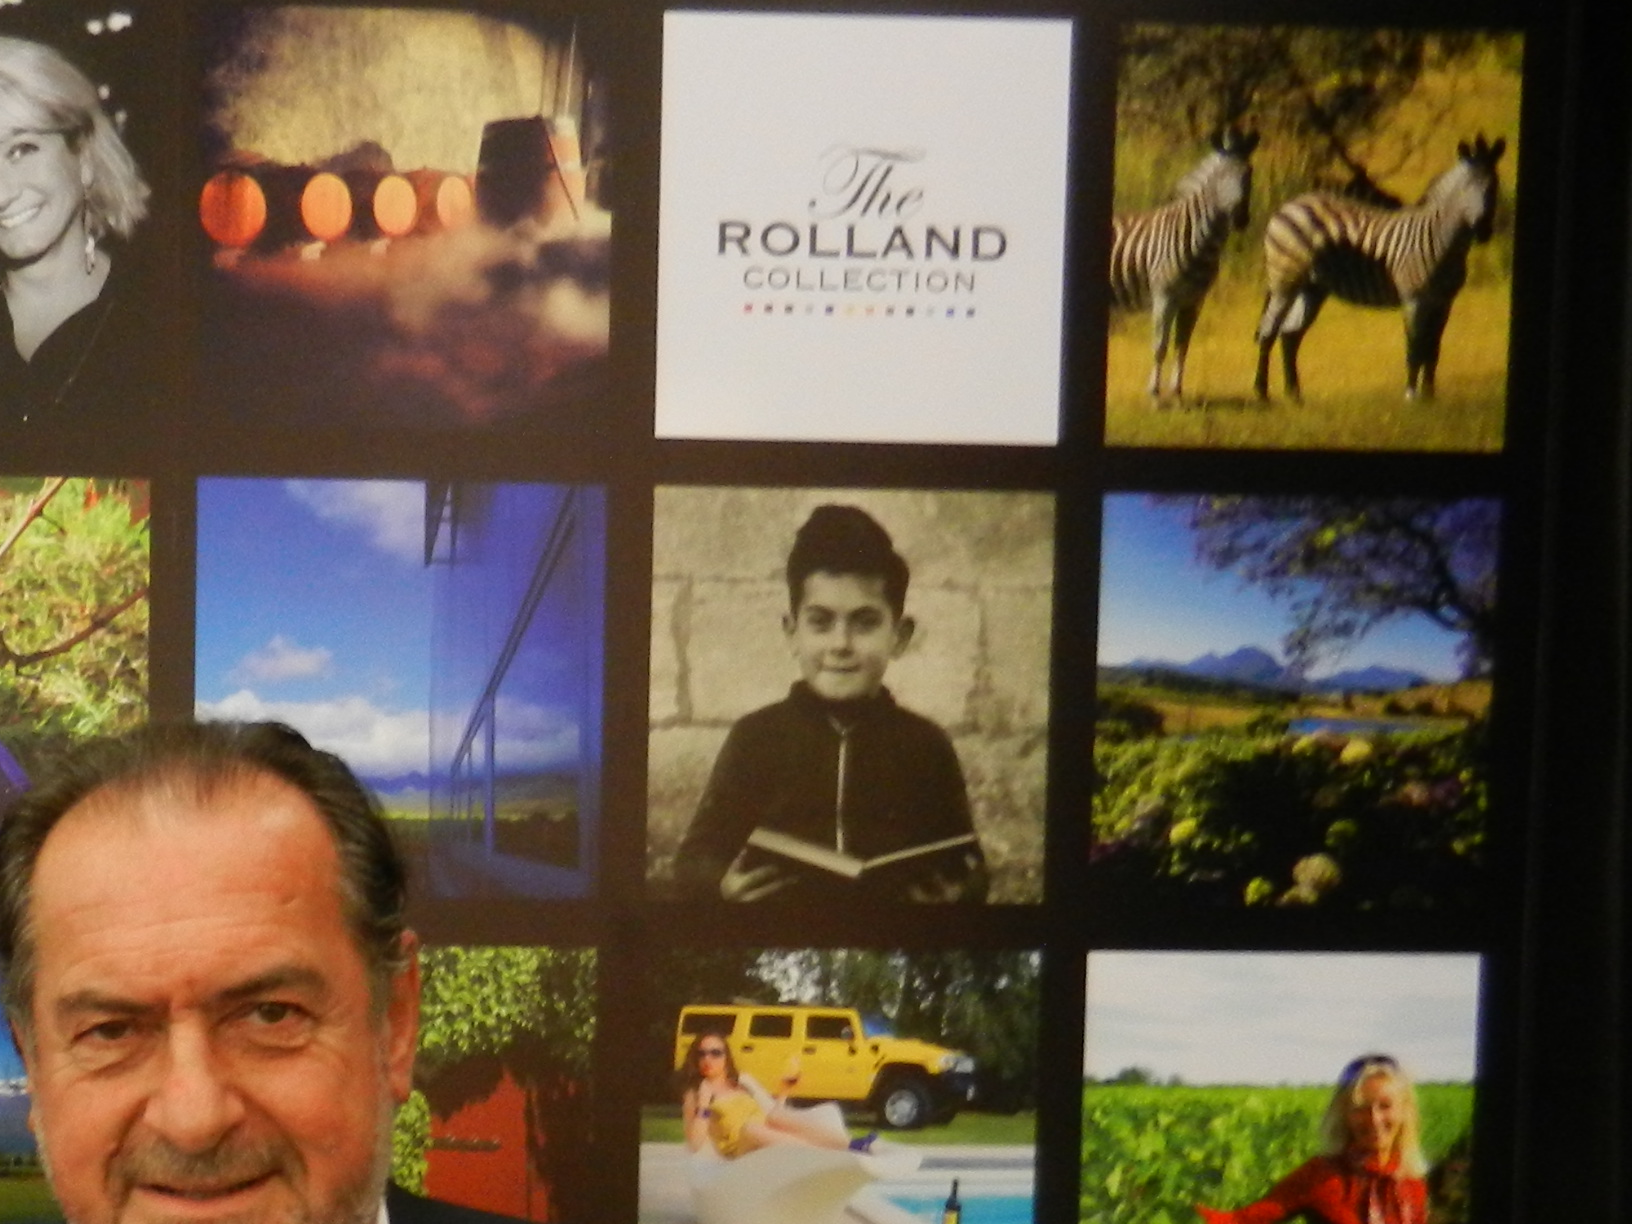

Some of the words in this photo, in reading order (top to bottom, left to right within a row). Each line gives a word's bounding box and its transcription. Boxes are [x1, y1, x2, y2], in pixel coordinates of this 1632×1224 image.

[808, 145, 928, 219] The
[717, 220, 1008, 263] ROLLAND
[742, 265, 977, 295] COLLECTION
